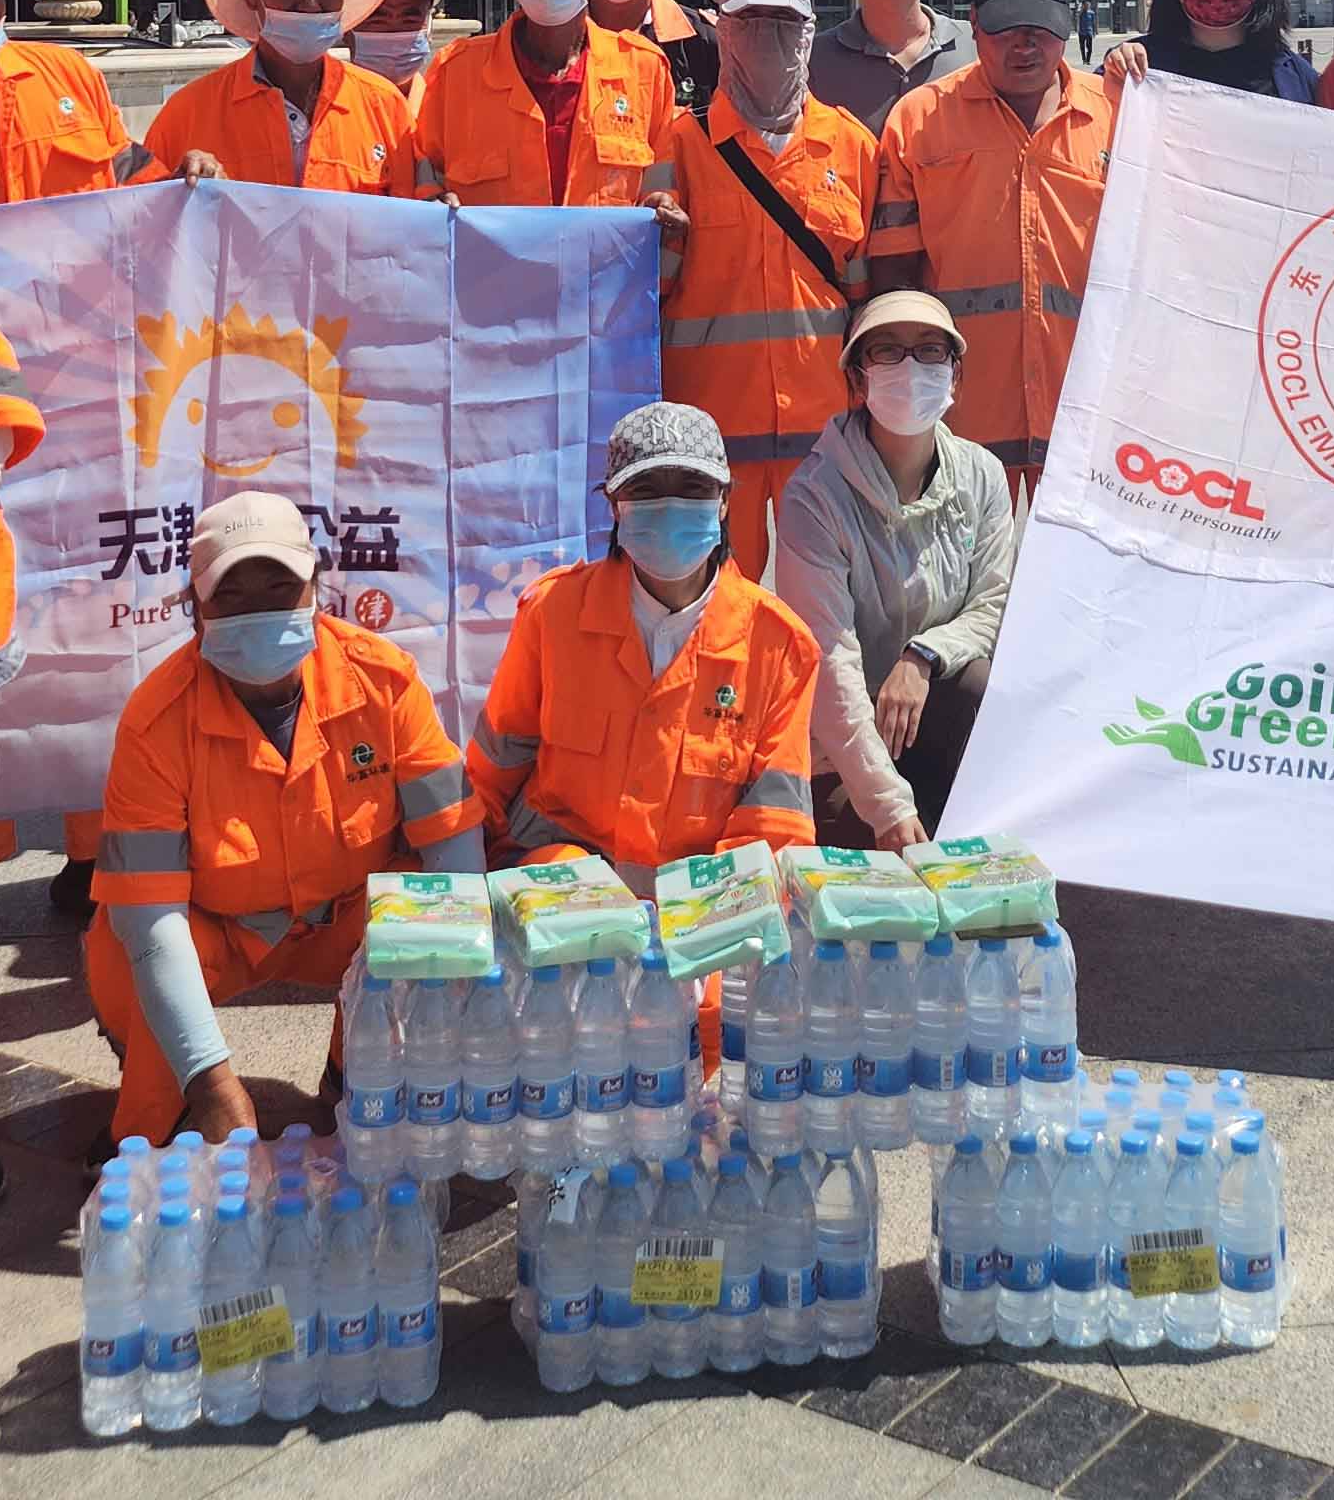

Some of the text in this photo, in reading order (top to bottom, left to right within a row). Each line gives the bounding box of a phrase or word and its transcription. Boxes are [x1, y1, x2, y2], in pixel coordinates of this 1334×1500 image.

[1275, 329, 1311, 412] OOCL
[1090, 468, 1282, 546] We take it personally
[1115, 443, 1265, 521] OOCL
[109, 602, 172, 629] Pure
[359, 591, 389, 627] 津
